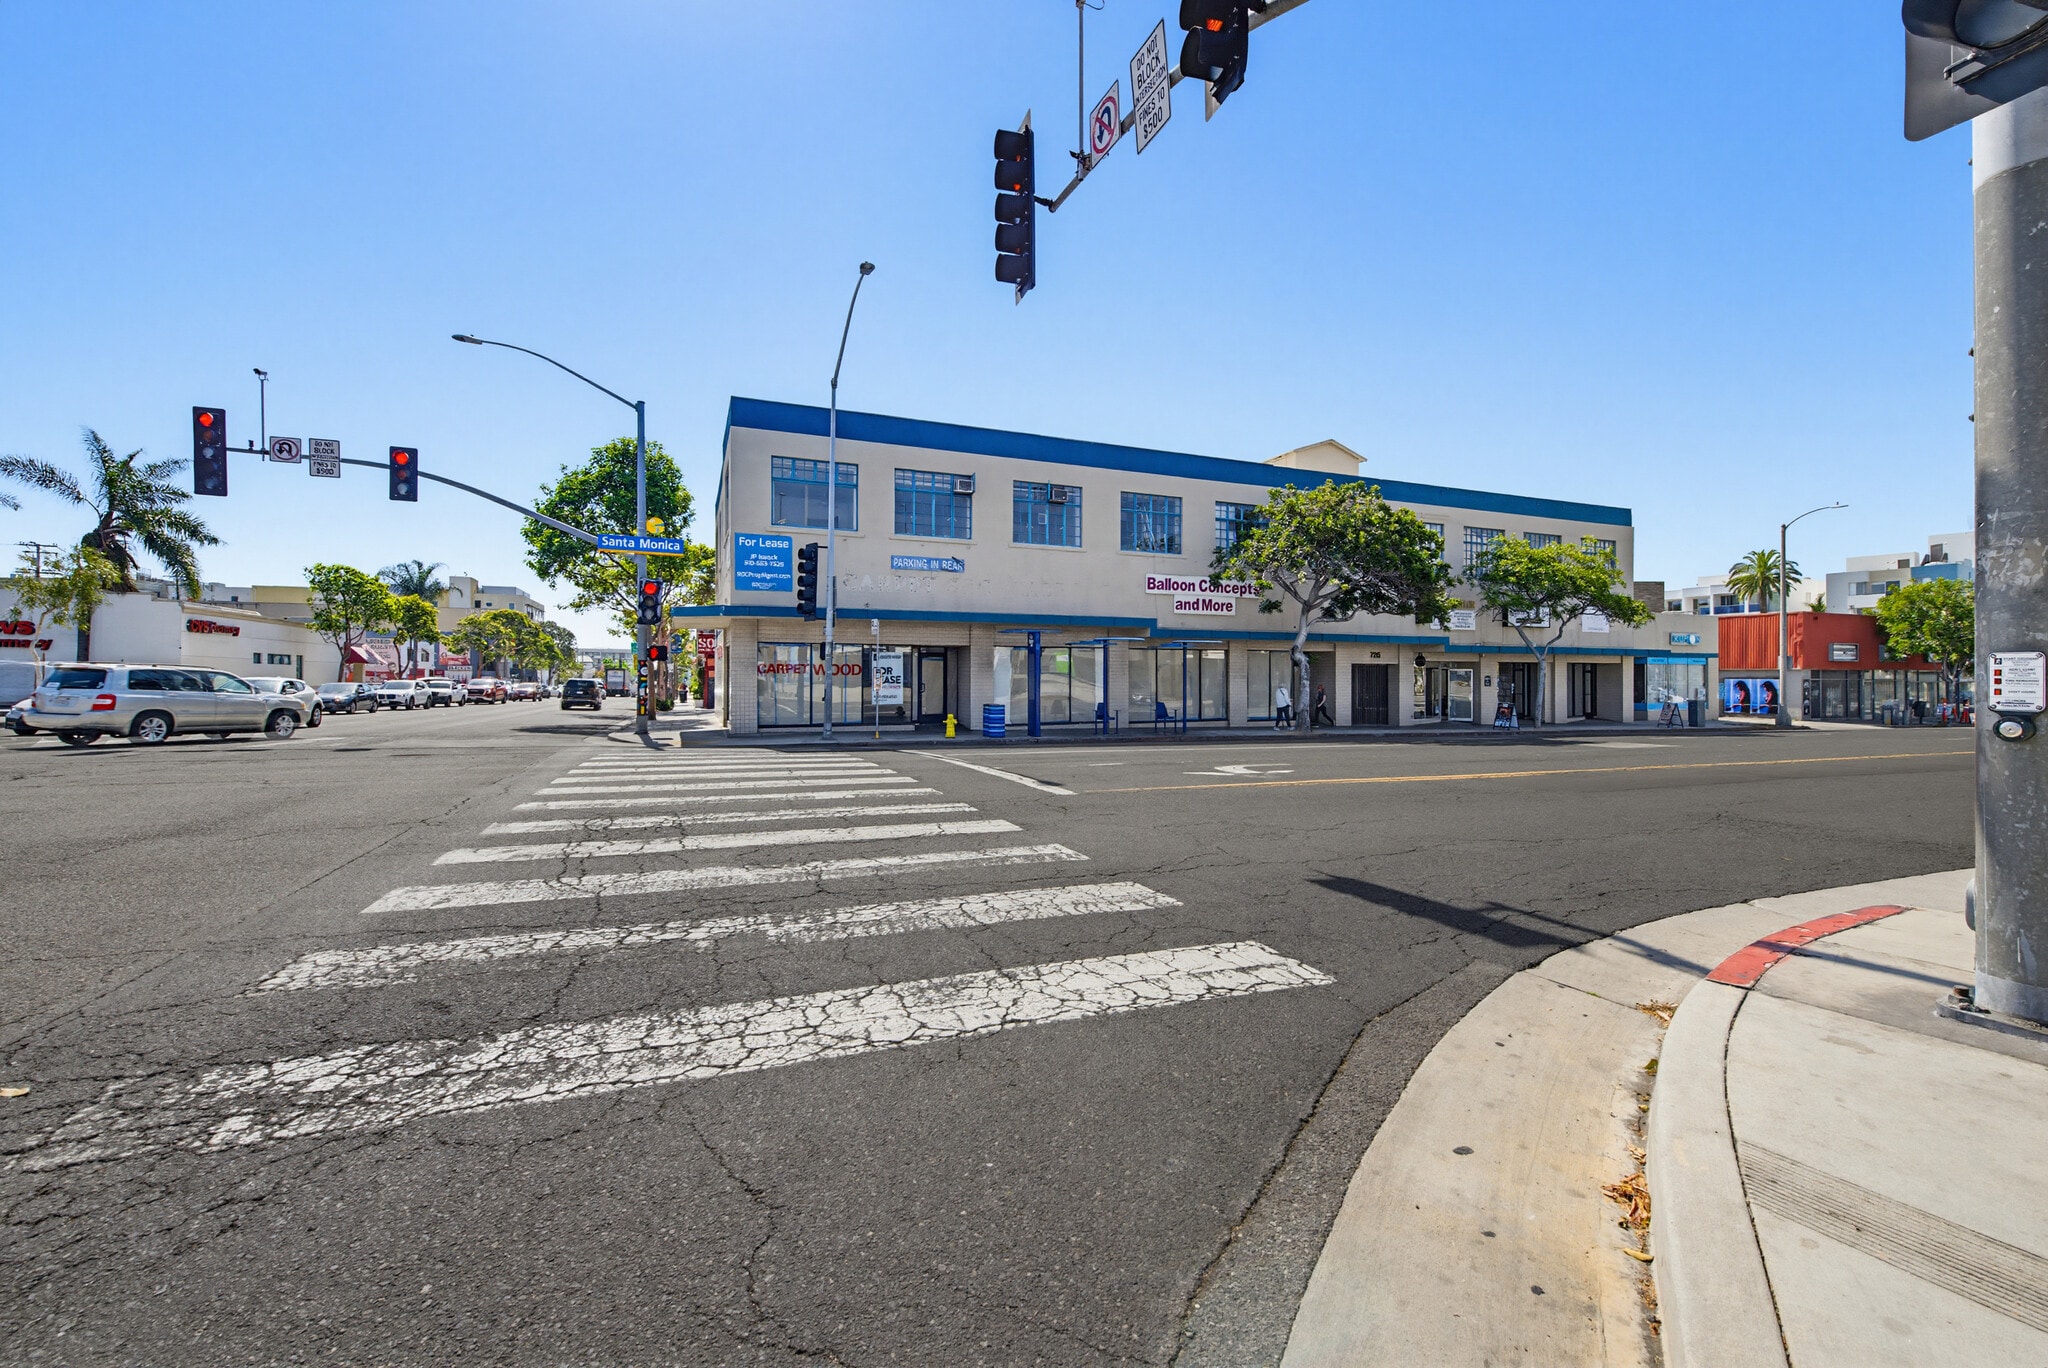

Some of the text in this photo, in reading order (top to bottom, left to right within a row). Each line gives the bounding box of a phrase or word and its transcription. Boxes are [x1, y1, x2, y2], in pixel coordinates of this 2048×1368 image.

[1136, 34, 1159, 71] DO NOT
[1136, 50, 1162, 90] BLOCK
[1135, 63, 1166, 105] INTERSECTION
[1138, 86, 1165, 125] FINES TO
[1143, 106, 1163, 139] $500
[313, 447, 335, 455] BLOCK
[601, 536, 681, 551] Santa Monica
[738, 536, 790, 549] For Lease
[893, 557, 964, 571] PARKING IN REAR
[1147, 577, 1261, 598] Balloon Concepts
[1175, 598, 1234, 612] and More
[0, 620, 36, 635] VS
[757, 663, 809, 676] CARPET
[880, 675, 902, 685] ASE
